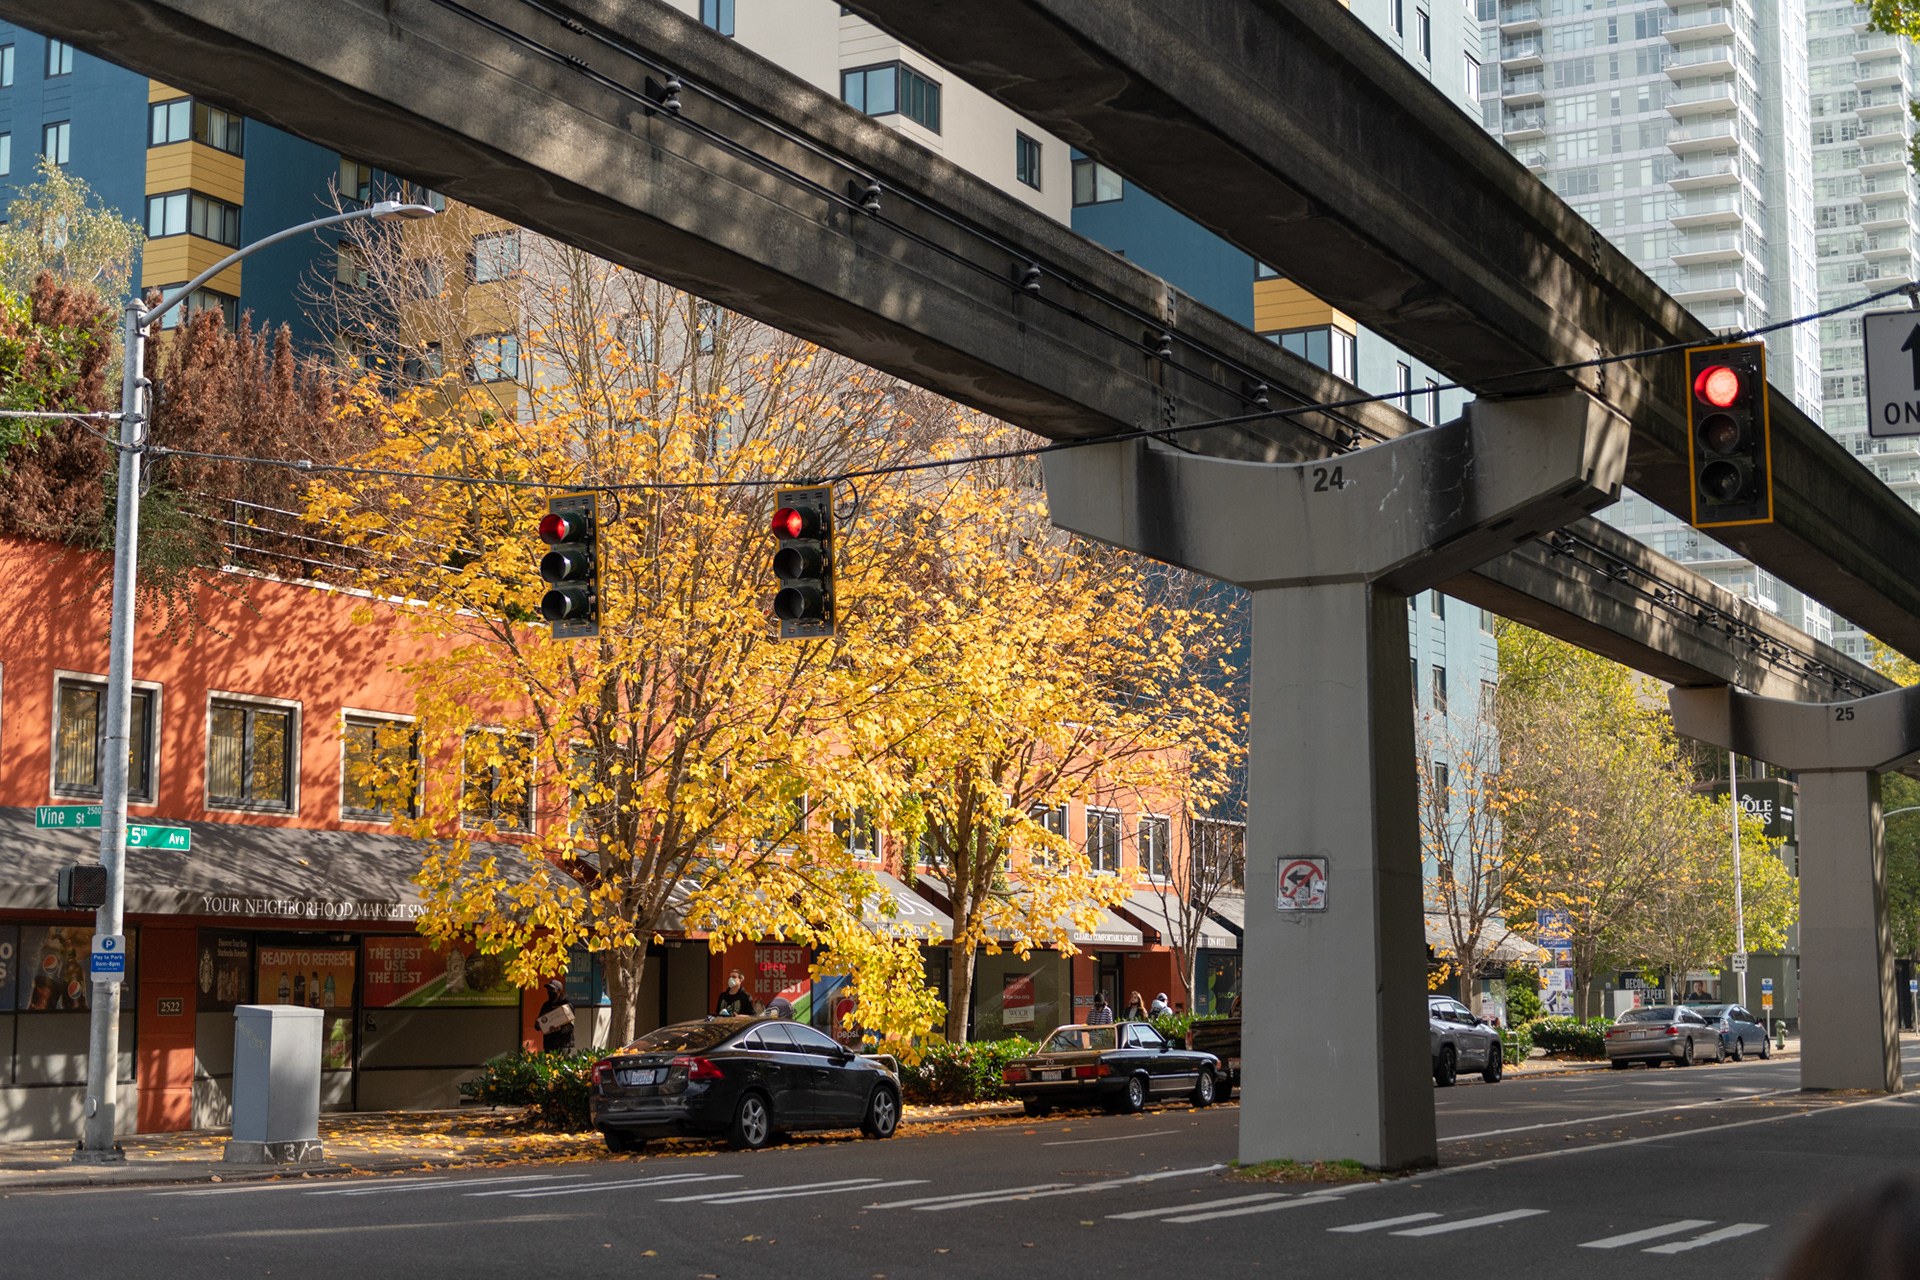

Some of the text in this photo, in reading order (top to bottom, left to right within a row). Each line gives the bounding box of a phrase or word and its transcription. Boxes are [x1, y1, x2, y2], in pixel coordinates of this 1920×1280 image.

[1884, 401, 1920, 425] ON
[1313, 466, 1343, 492] 24
[1835, 707, 1855, 721] 25
[1736, 799, 1773, 813] HOLE
[40, 806, 102, 825] Vine St 2500
[131, 827, 185, 845] 5th Ave
[203, 896, 240, 913] YOUR
[245, 899, 353, 917] NEIGHBORHOOD
[356, 903, 405, 918] MARKET
[408, 904, 430, 918] SIN
[261, 952, 353, 966] READY TO REFRESH
[368, 948, 422, 960] THE BEST
[755, 950, 803, 964] HE BEST
[384, 960, 406, 972] USE
[760, 962, 786, 971] OPEN
[764, 966, 787, 978] USE
[368, 972, 422, 983] THE BEST
[755, 980, 803, 993] HE BEST
[1643, 988, 1666, 999] EXPERT
[161, 1001, 180, 1012] 2522
